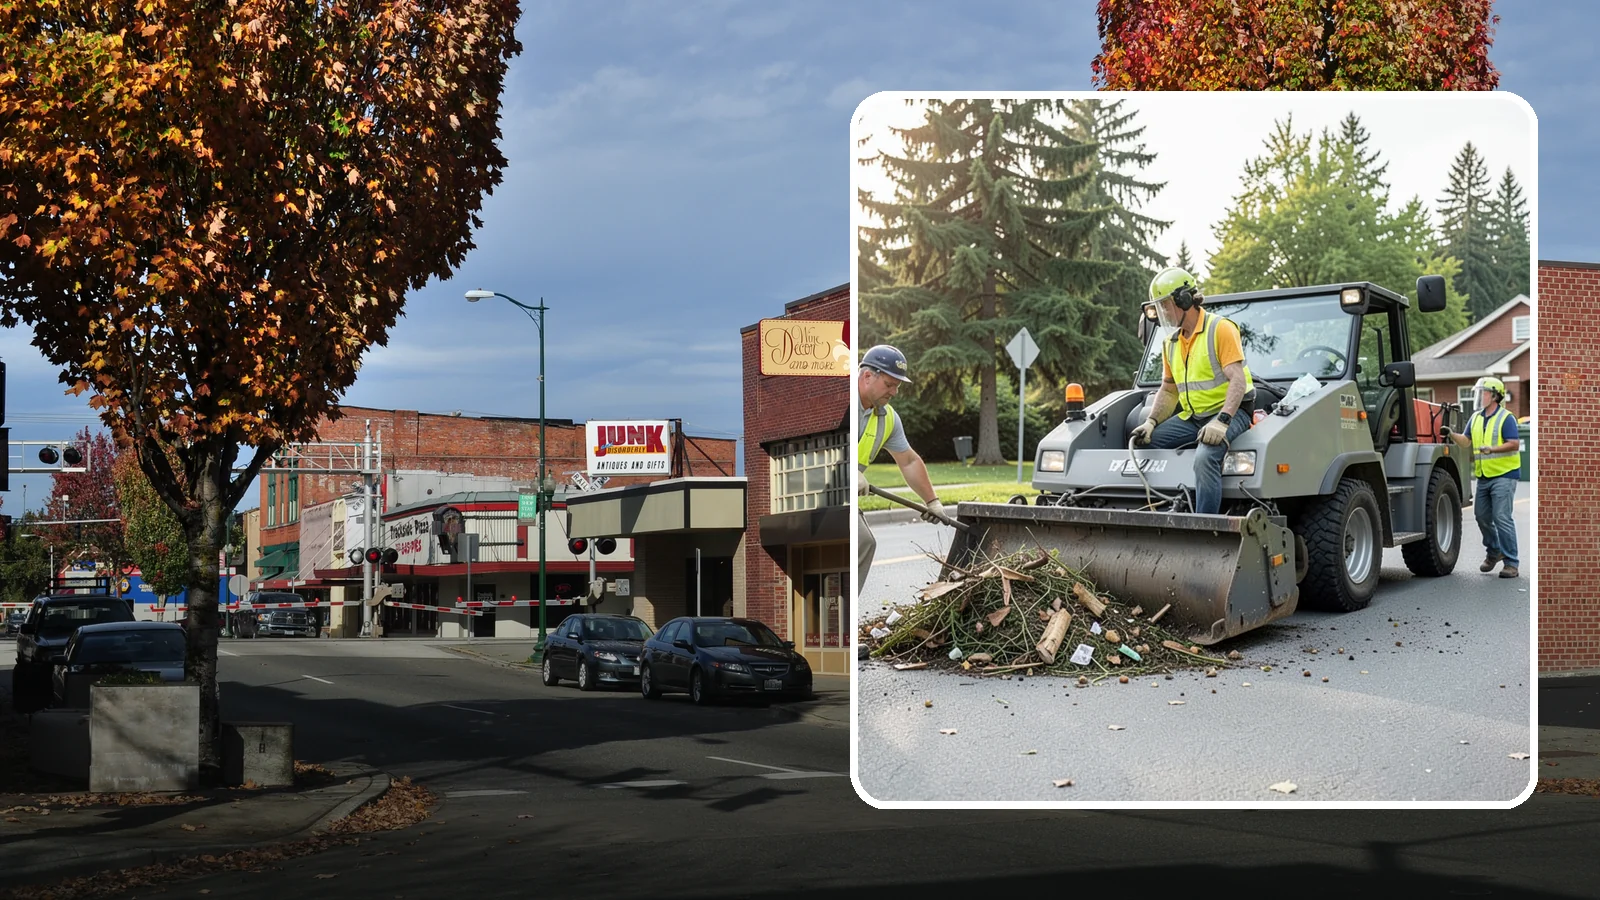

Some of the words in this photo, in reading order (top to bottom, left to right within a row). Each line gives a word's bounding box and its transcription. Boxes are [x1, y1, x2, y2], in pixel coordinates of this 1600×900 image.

[595, 425, 665, 457] JUNK
[608, 446, 646, 454] DISORDERLY
[597, 461, 628, 470] ANTIQUES
[631, 461, 644, 470] AND
[646, 460, 665, 469] GIFTS
[573, 474, 589, 492] RAIL
[352, 498, 365, 511] CRO
[390, 521, 413, 539] Trackside
[414, 519, 429, 535] Pizza
